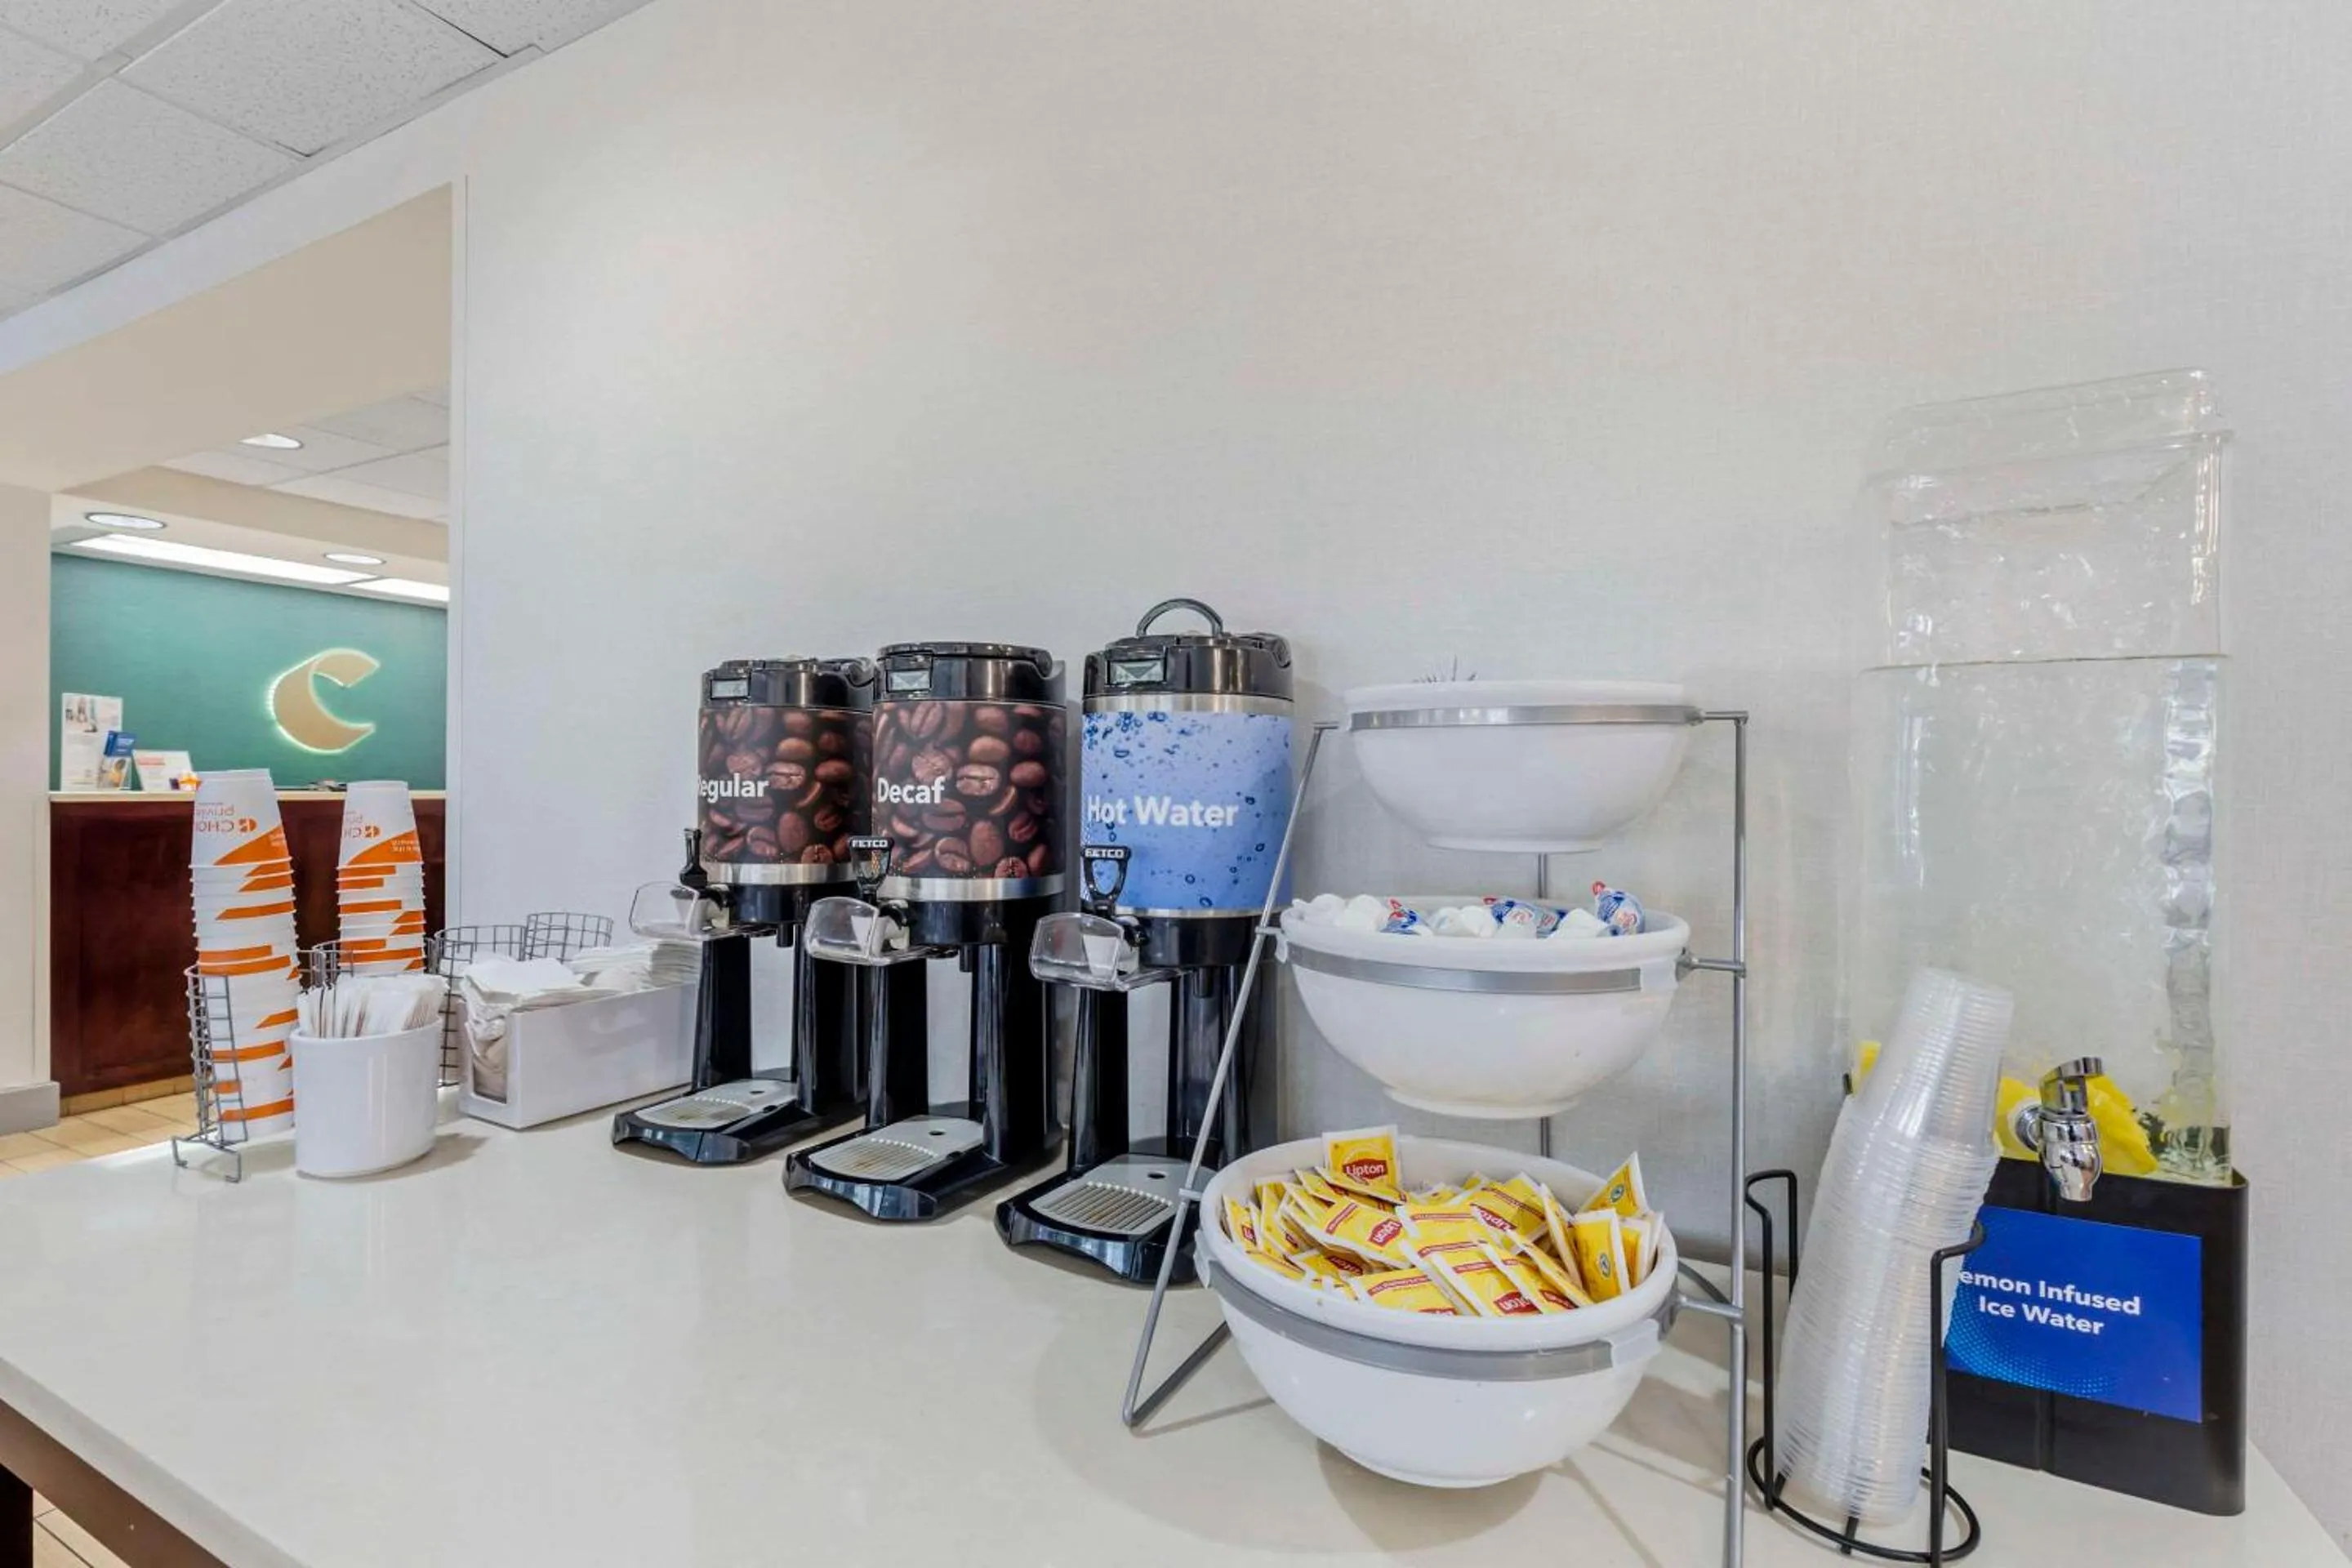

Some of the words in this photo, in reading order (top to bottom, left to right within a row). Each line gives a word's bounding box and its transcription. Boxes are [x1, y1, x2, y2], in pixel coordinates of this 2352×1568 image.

[877, 776, 946, 804] Decaf
[1087, 795, 1127, 825] Hot
[1134, 795, 1240, 827] Water
[852, 839, 889, 849] FETCO
[1085, 848, 1125, 858] FETCO
[1345, 1163, 1385, 1177] Lipton
[1959, 1270, 2032, 1296] emon
[2038, 1280, 2141, 1316] Infused
[1979, 1294, 2016, 1318] Ice
[2021, 1303, 2105, 1335] Water
